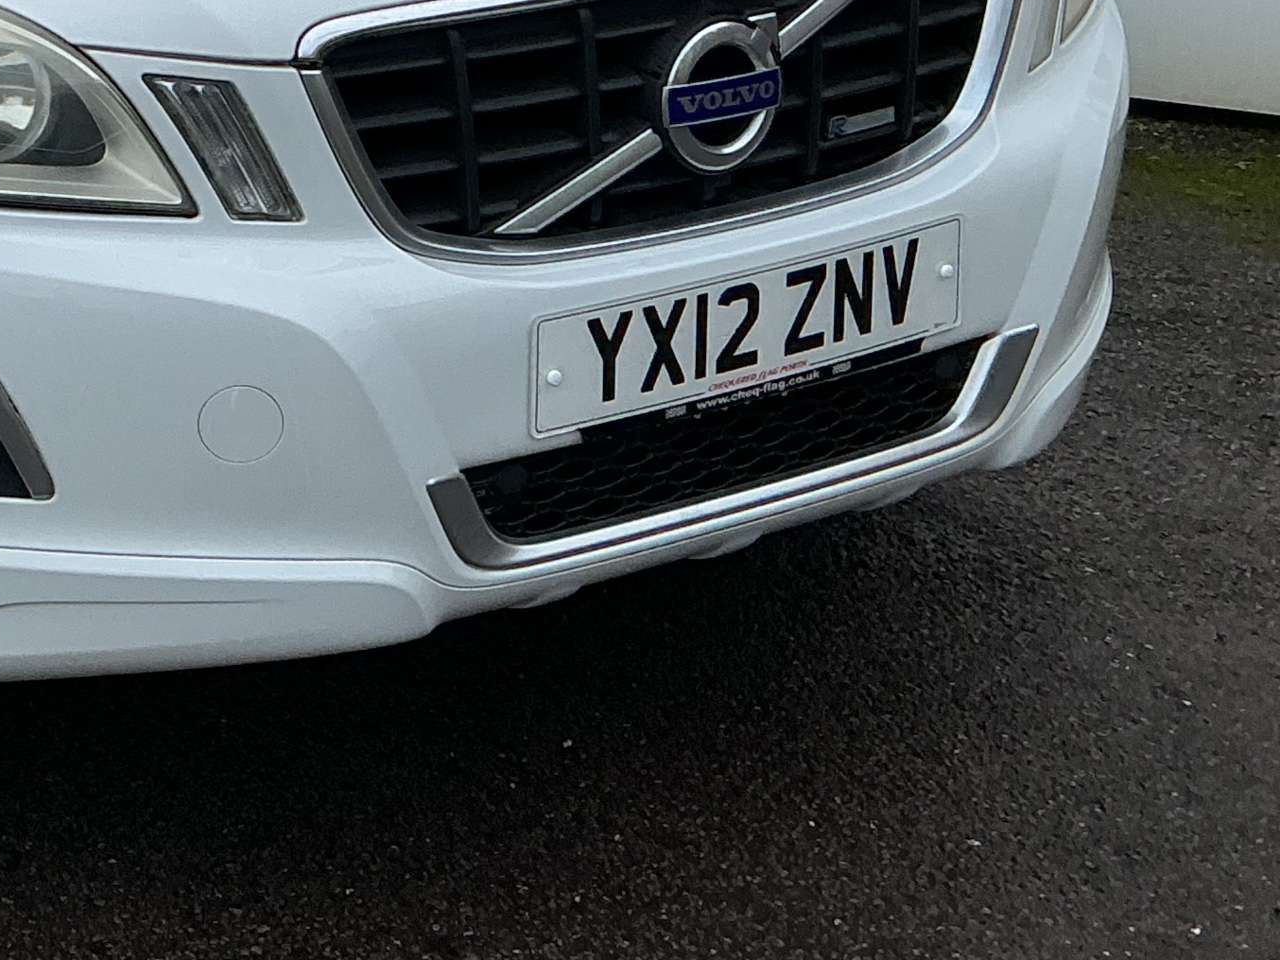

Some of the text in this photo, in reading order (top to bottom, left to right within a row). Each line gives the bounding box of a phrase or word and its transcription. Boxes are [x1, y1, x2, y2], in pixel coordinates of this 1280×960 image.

[677, 79, 775, 114] VOLVO
[586, 237, 920, 403] YX12 ZNV
